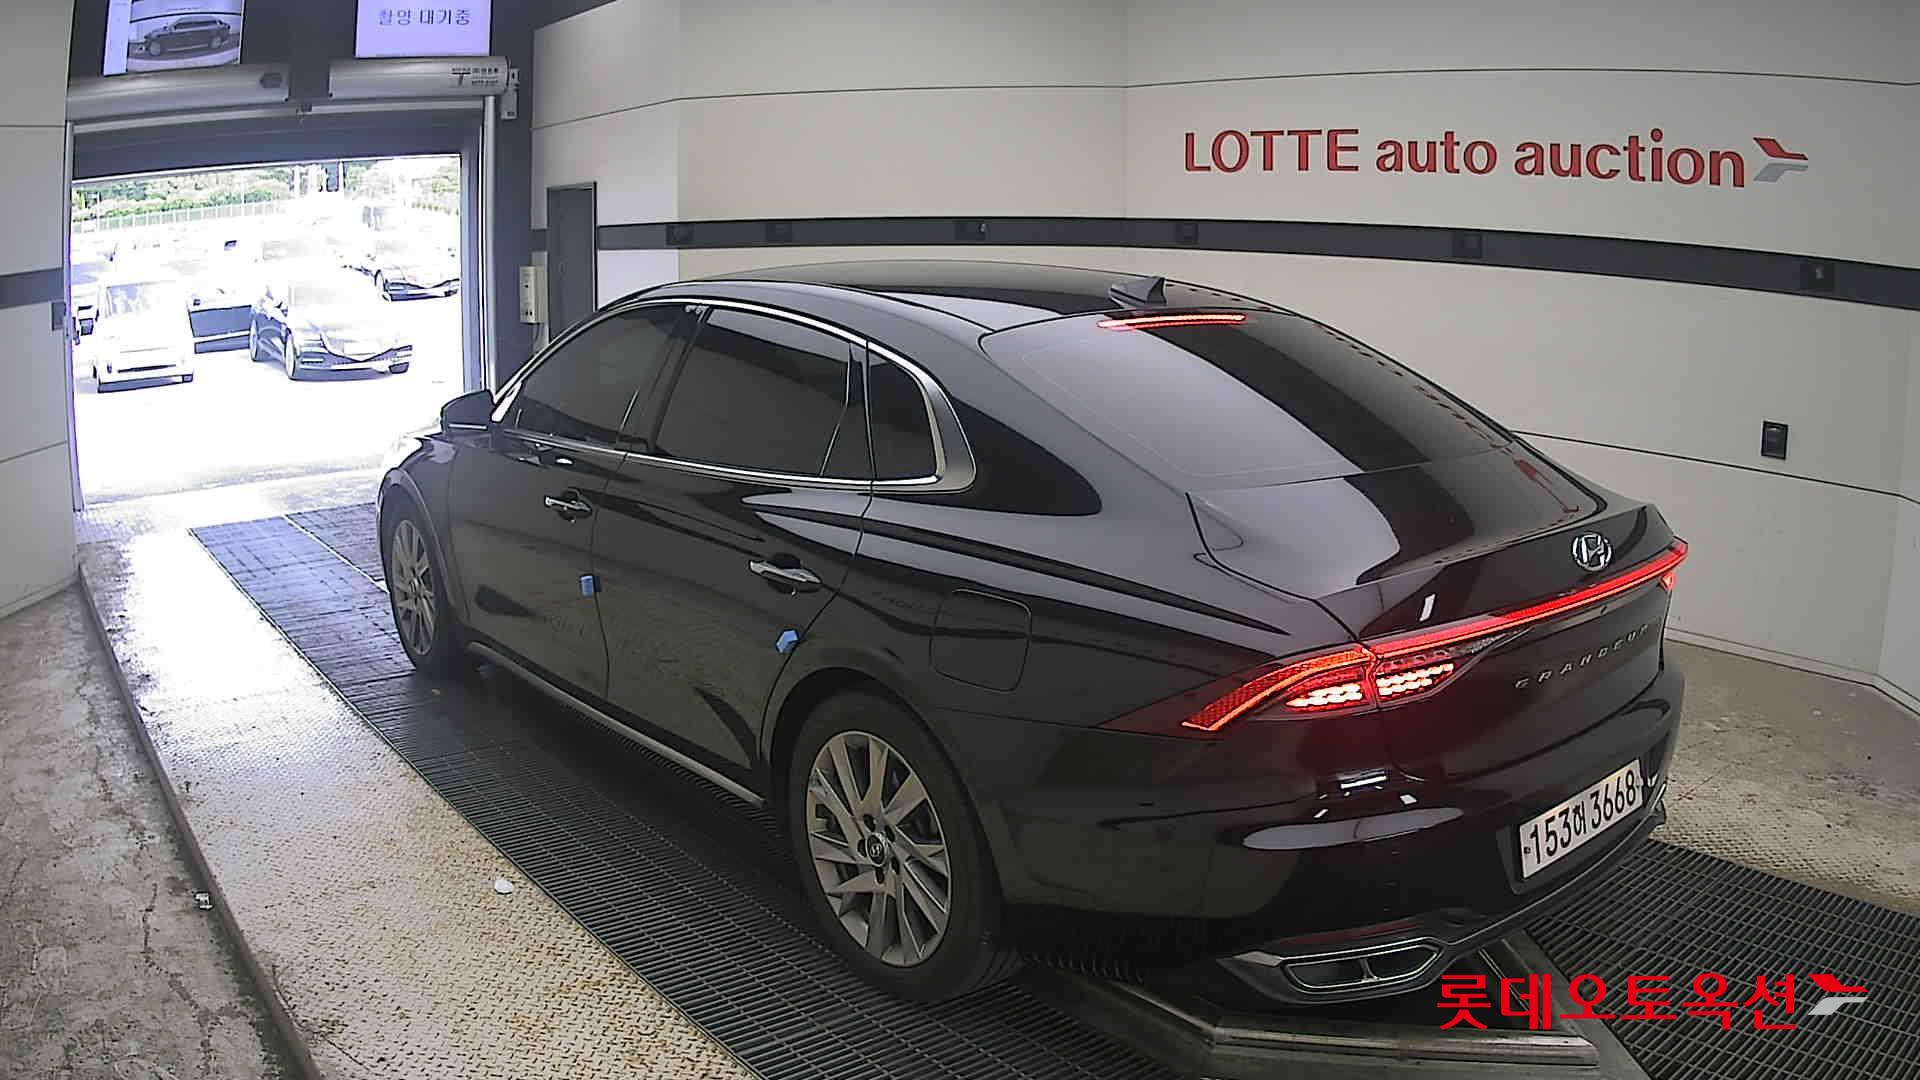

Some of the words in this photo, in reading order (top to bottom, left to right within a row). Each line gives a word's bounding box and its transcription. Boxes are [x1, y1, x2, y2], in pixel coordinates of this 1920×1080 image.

[419, 8, 470, 26] 대기중
[1185, 129, 1359, 173] LOTTE
[1376, 131, 1498, 175] auto
[1514, 128, 1745, 188] auction
[1515, 623, 1649, 689] GRANDEUR
[1590, 769, 1636, 829] 3668
